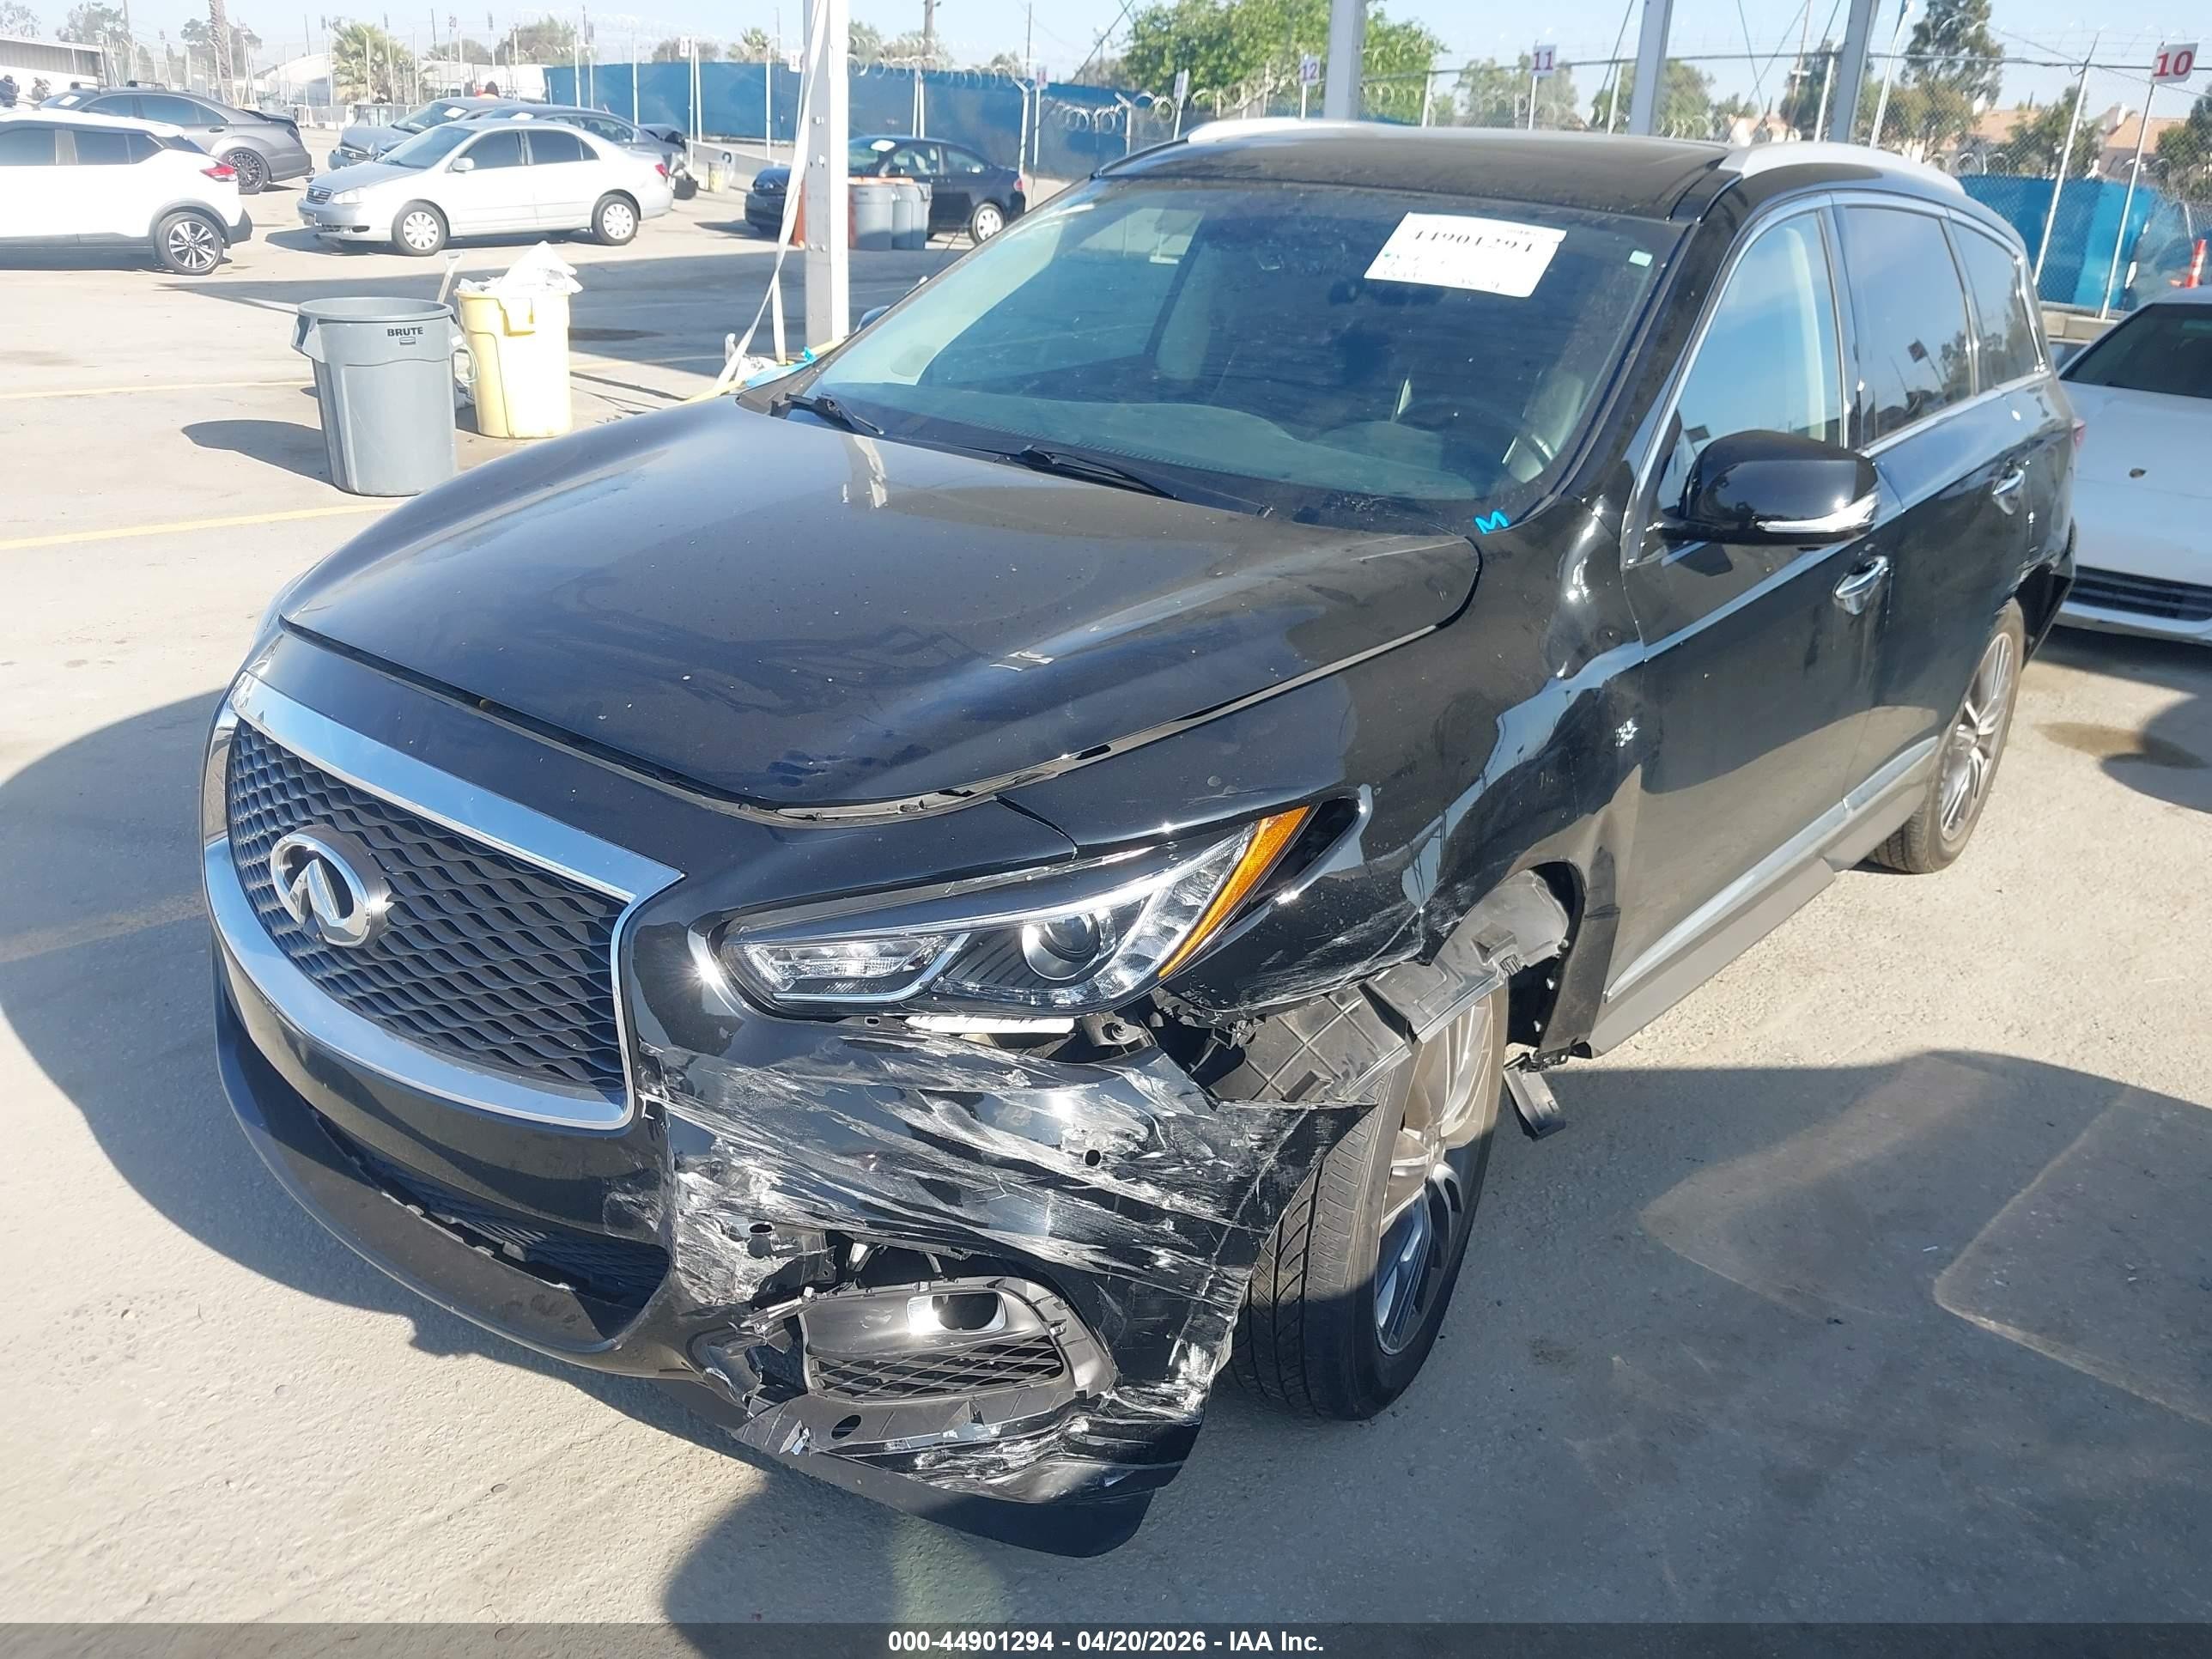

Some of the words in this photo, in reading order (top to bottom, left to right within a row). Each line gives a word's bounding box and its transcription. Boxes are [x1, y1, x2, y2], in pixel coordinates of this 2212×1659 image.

[1533, 52, 1553, 70] 11
[2153, 51, 2192, 77] 10
[1302, 63, 1317, 82] 12
[386, 326, 424, 337] BRUTE
